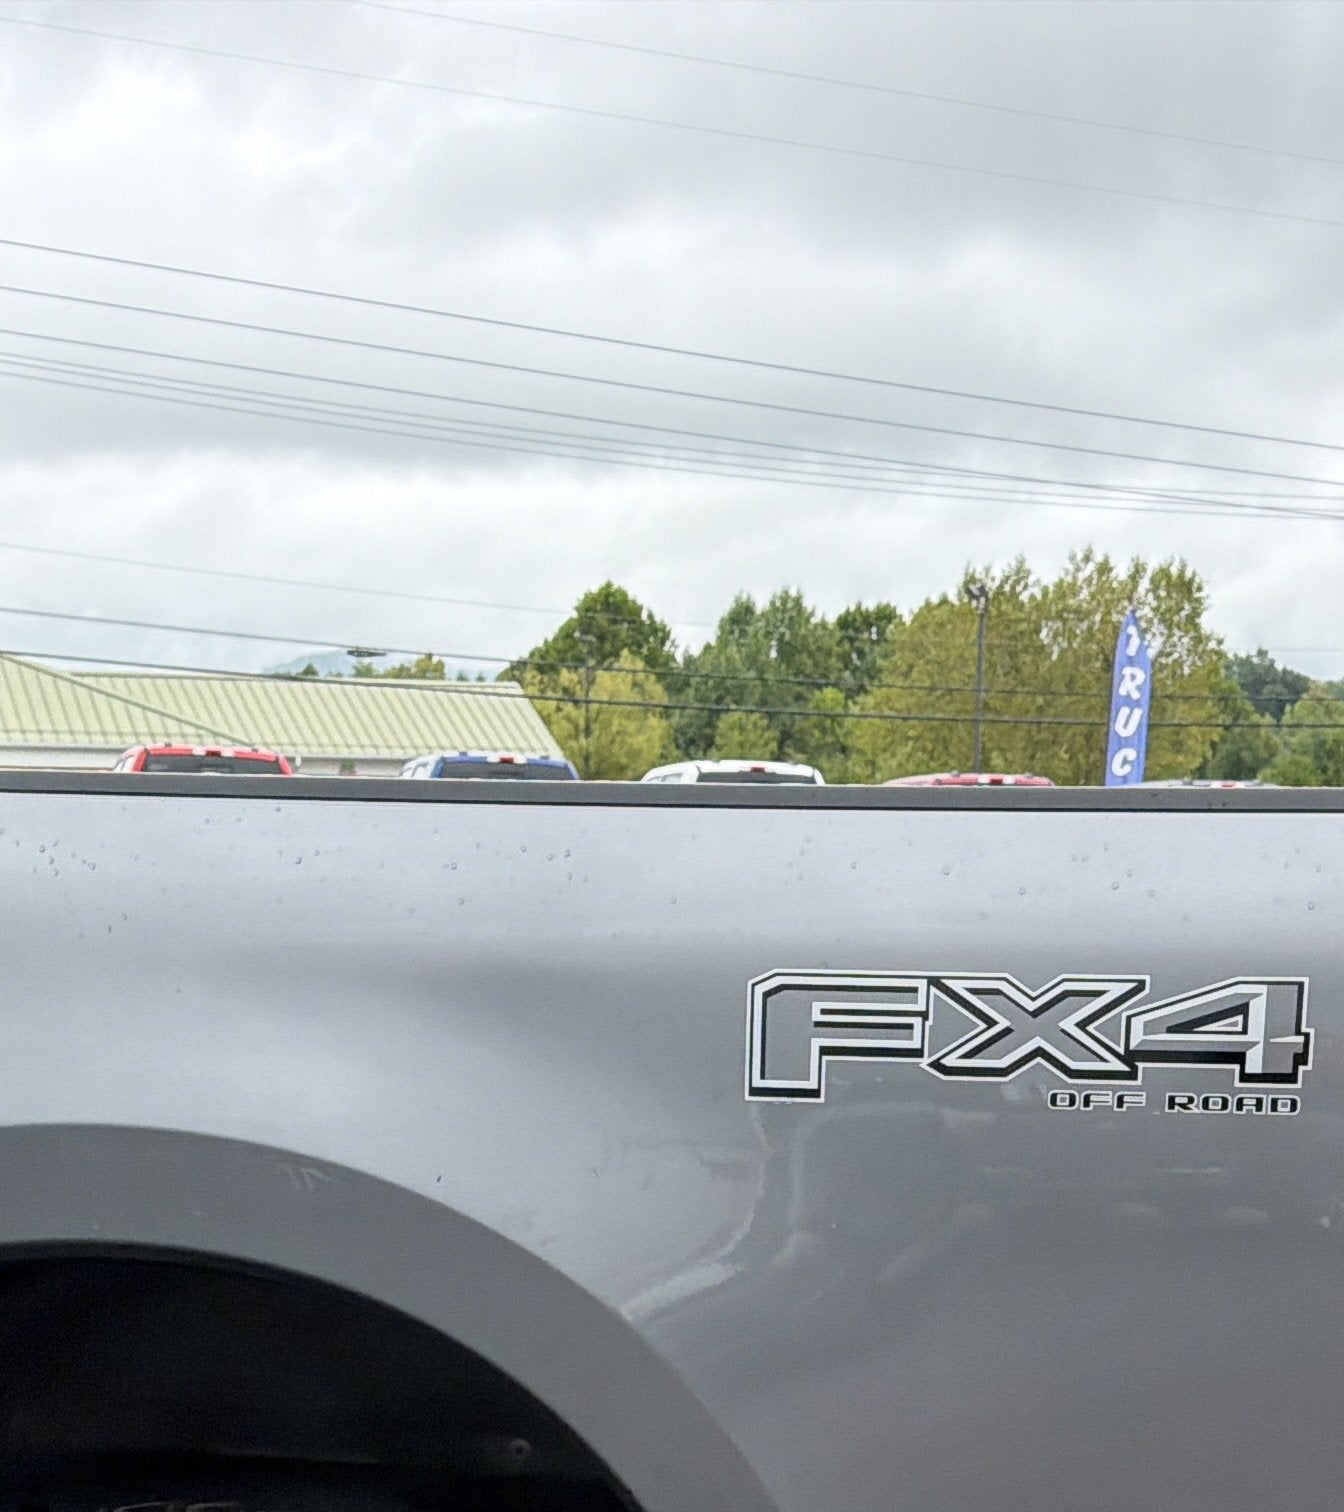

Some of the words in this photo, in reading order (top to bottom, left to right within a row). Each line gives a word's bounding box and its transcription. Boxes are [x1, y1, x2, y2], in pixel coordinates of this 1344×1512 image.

[746, 968, 1315, 1103] FX4
[1047, 1089, 1147, 1111] OFF
[1165, 1093, 1301, 1115] ROAD
